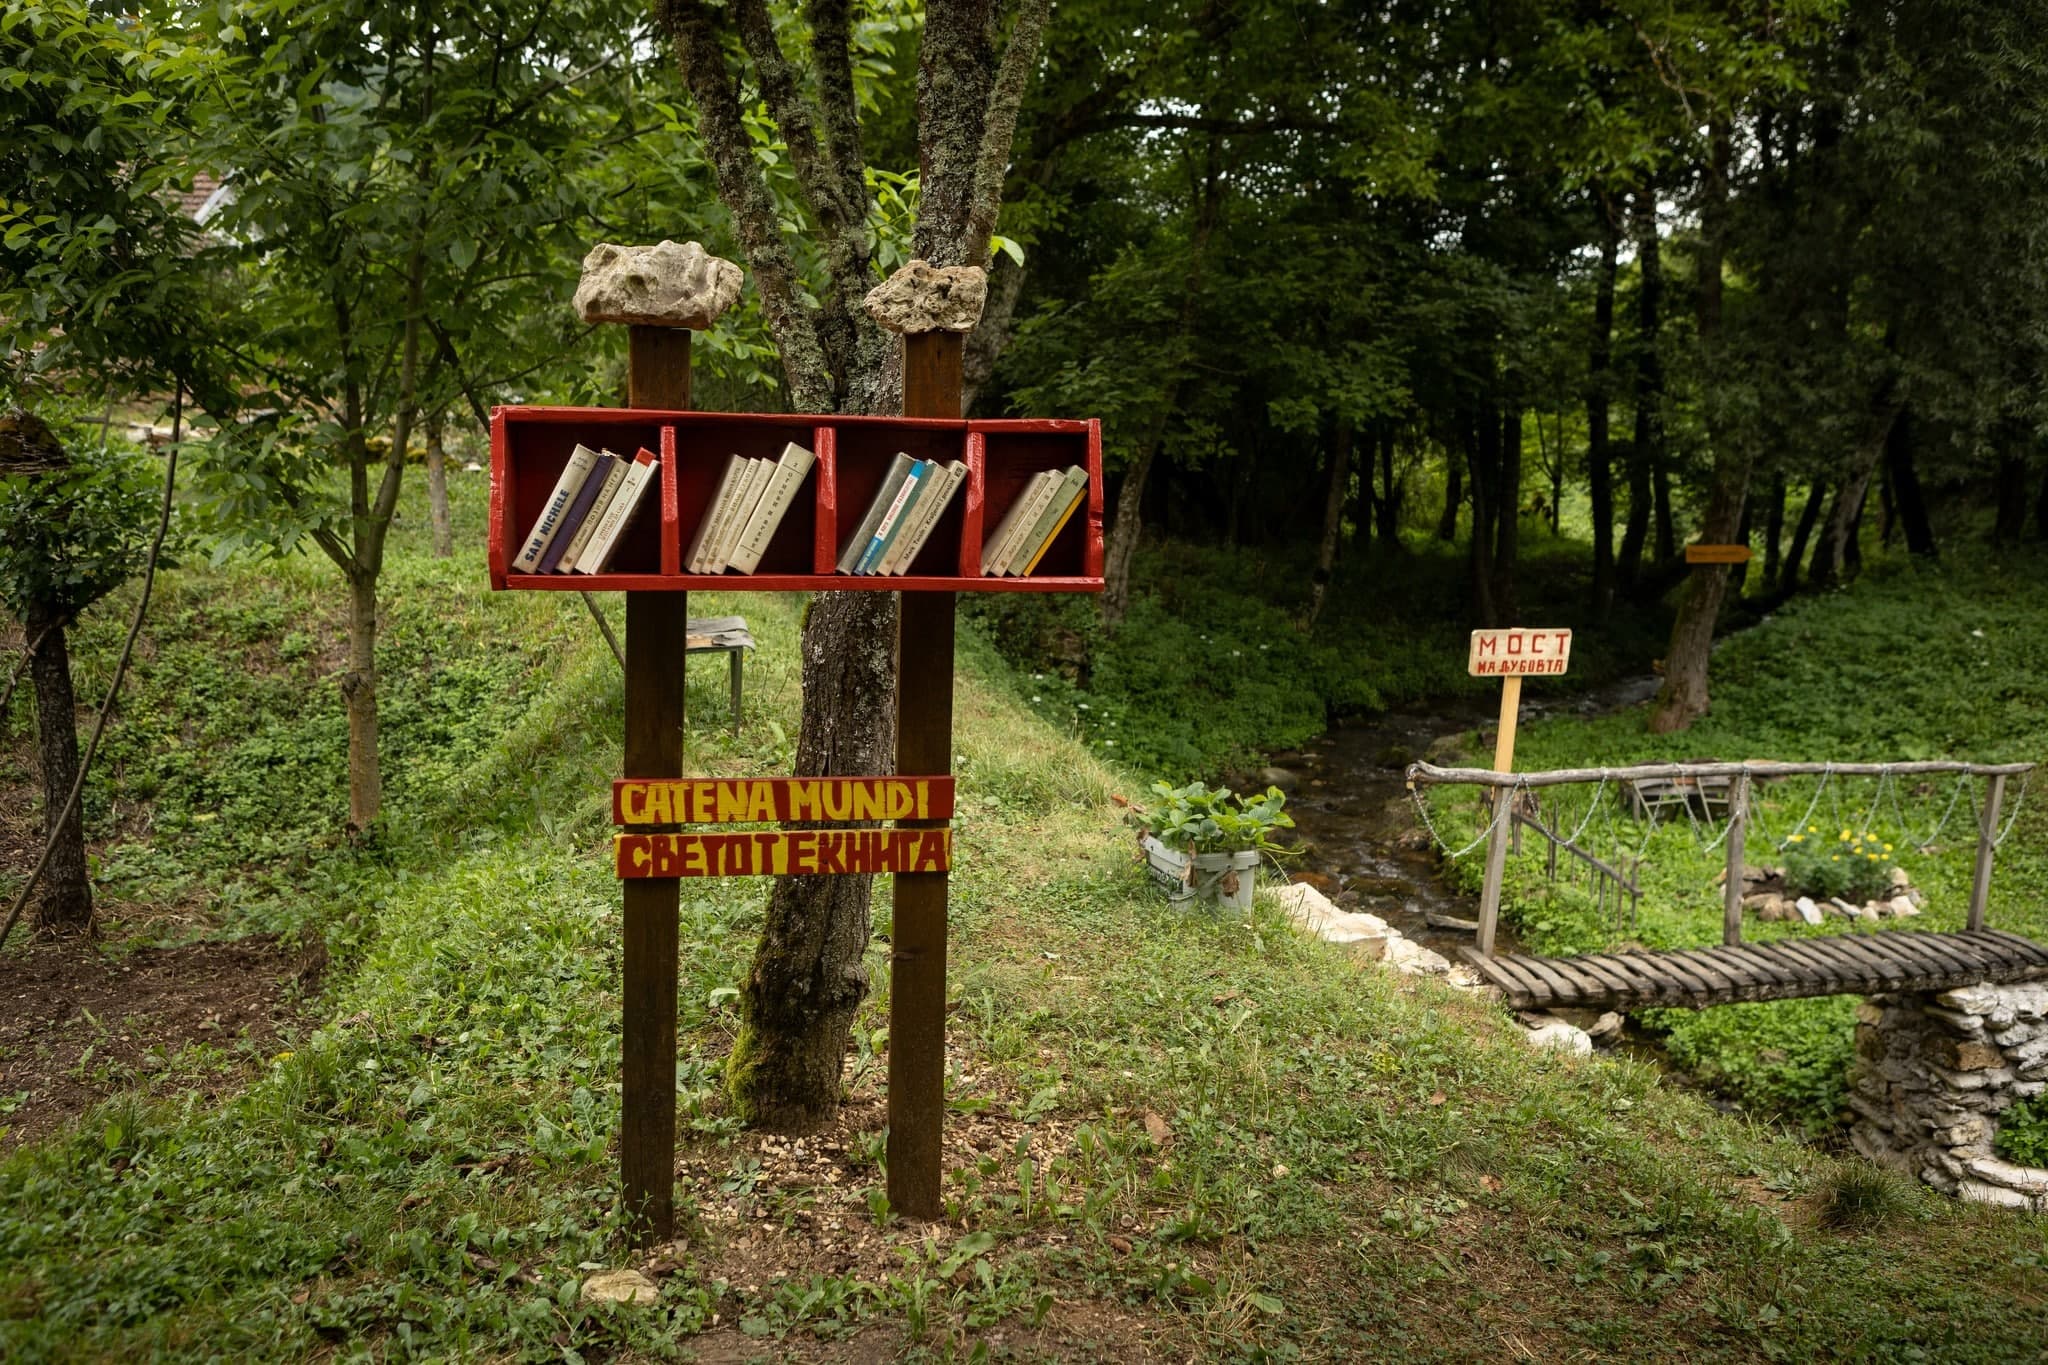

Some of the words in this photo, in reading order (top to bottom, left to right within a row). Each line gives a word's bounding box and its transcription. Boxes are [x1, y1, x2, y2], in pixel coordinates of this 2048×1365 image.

[525, 538, 543, 562] SAN
[539, 489, 570, 536] MICHELE
[1479, 633, 1569, 656] МОСТ
[1477, 661, 1496, 674] НА
[621, 781, 778, 824] CATENA
[787, 780, 930, 821] MUNDI
